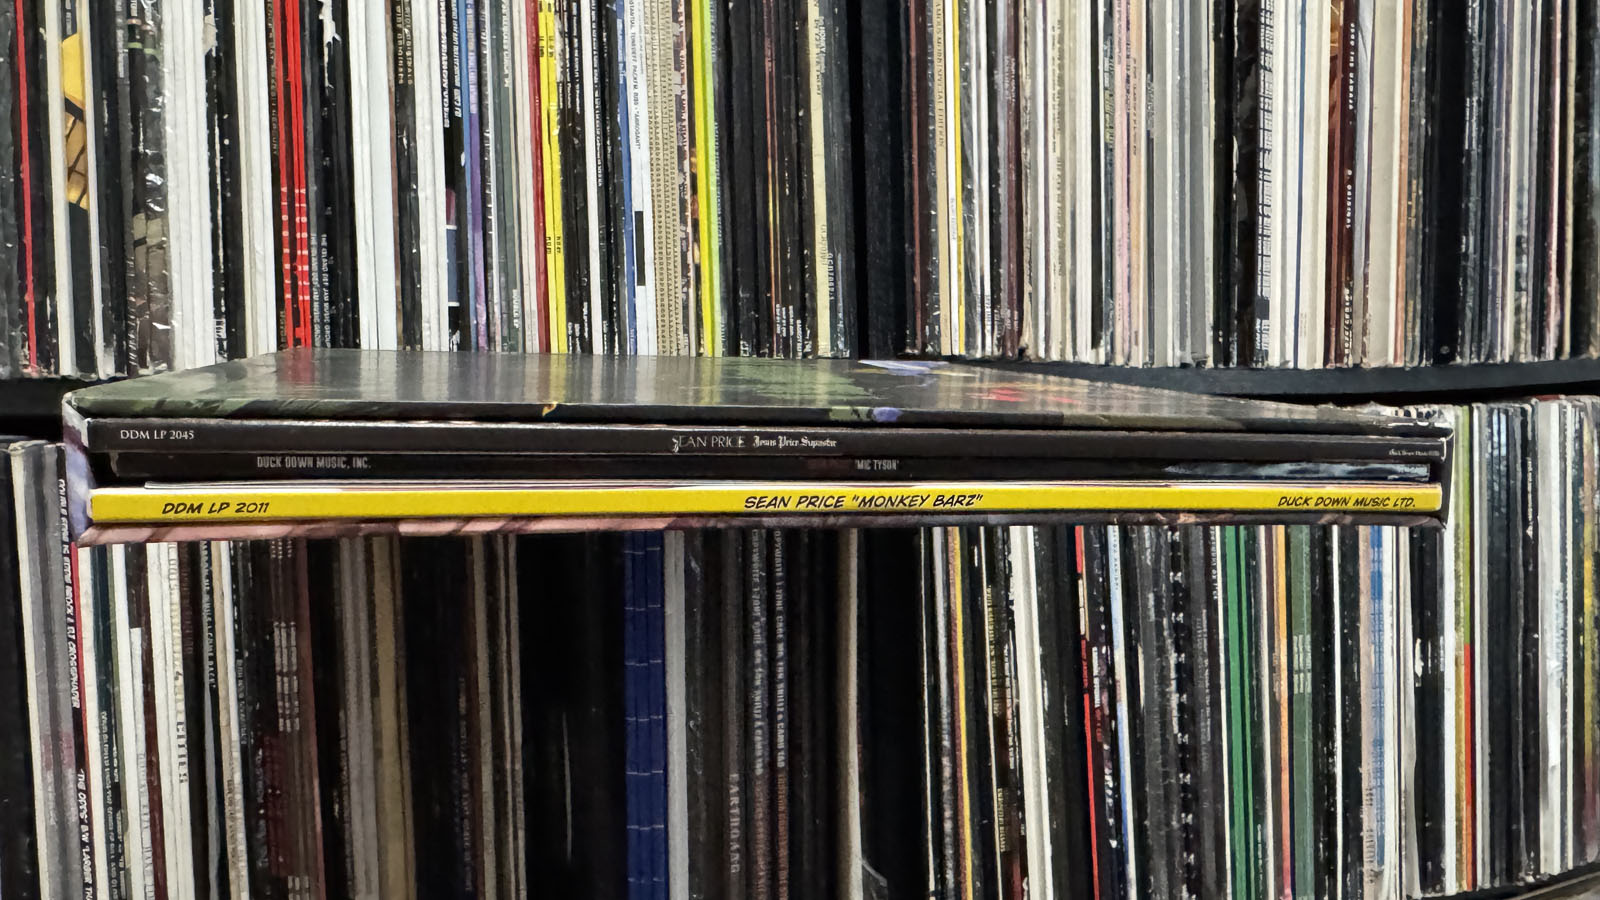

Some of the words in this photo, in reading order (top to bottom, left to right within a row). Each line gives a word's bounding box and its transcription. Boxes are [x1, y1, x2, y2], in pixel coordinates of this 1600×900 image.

[119, 429, 151, 441] DDM
[153, 429, 167, 441] LP
[168, 429, 195, 441] 2045
[710, 434, 745, 448] PRICE
[257, 456, 281, 469] DUCK
[285, 456, 313, 469] DOWN
[162, 501, 202, 515] DDM
[207, 501, 230, 514] LP
[235, 500, 270, 514] 2011
[744, 494, 791, 509] SEAN
[796, 494, 845, 509] PRICE
[852, 494, 930, 509] "MONKEY
[933, 493, 984, 508] BARZ"
[1278, 495, 1312, 508] DUCK
[1314, 495, 1351, 508] DOWN
[1353, 495, 1391, 508] MUSIC
[1393, 496, 1416, 509] LTD.
